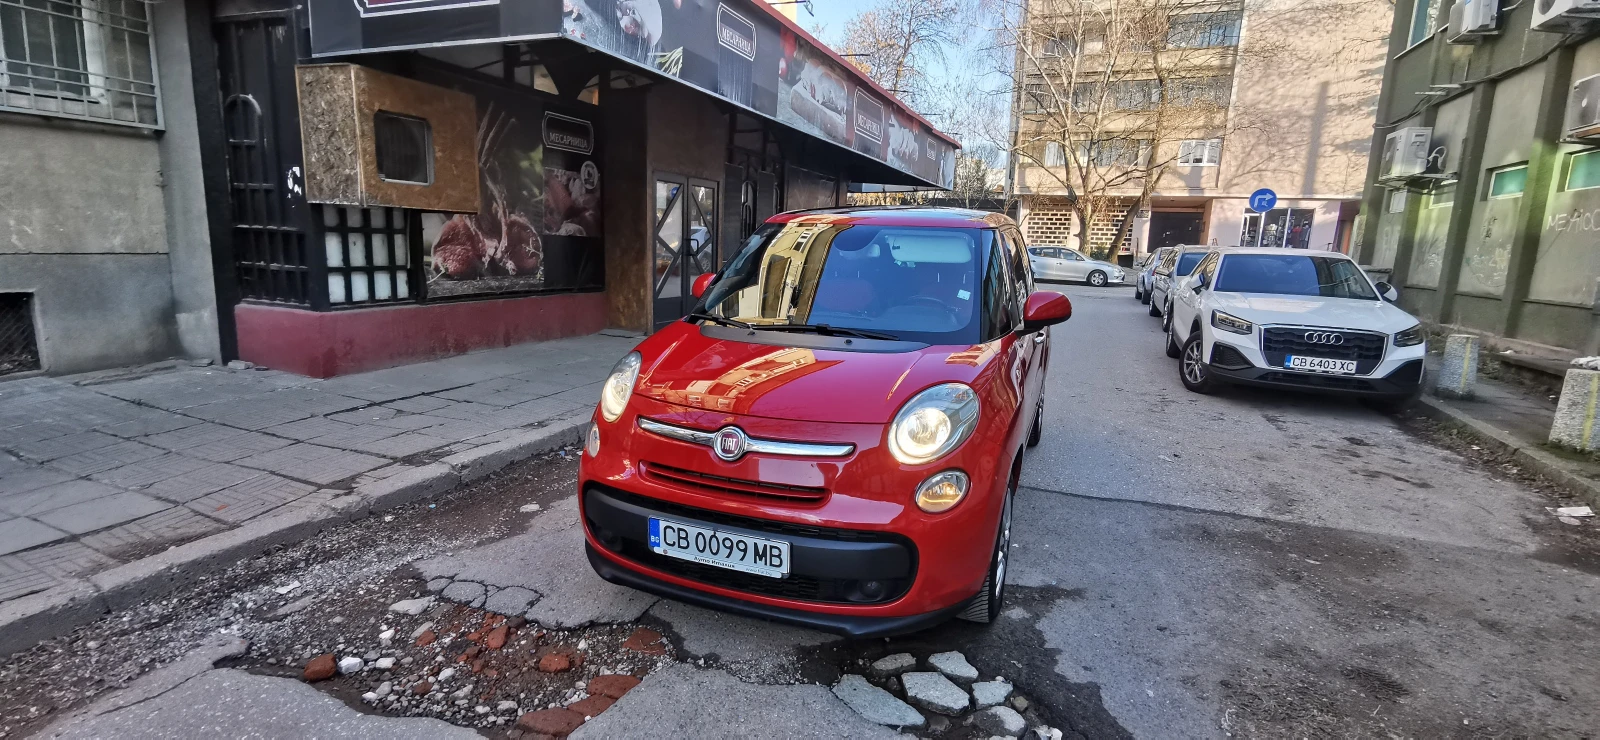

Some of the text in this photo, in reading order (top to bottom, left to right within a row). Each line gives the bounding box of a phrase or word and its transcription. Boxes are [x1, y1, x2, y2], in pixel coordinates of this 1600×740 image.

[549, 132, 588, 148] МЕСАРНИЦА
[1292, 357, 1355, 371] CB 6403 XC
[722, 437, 737, 451] FIAT
[663, 525, 783, 568] CB 0099 MB
